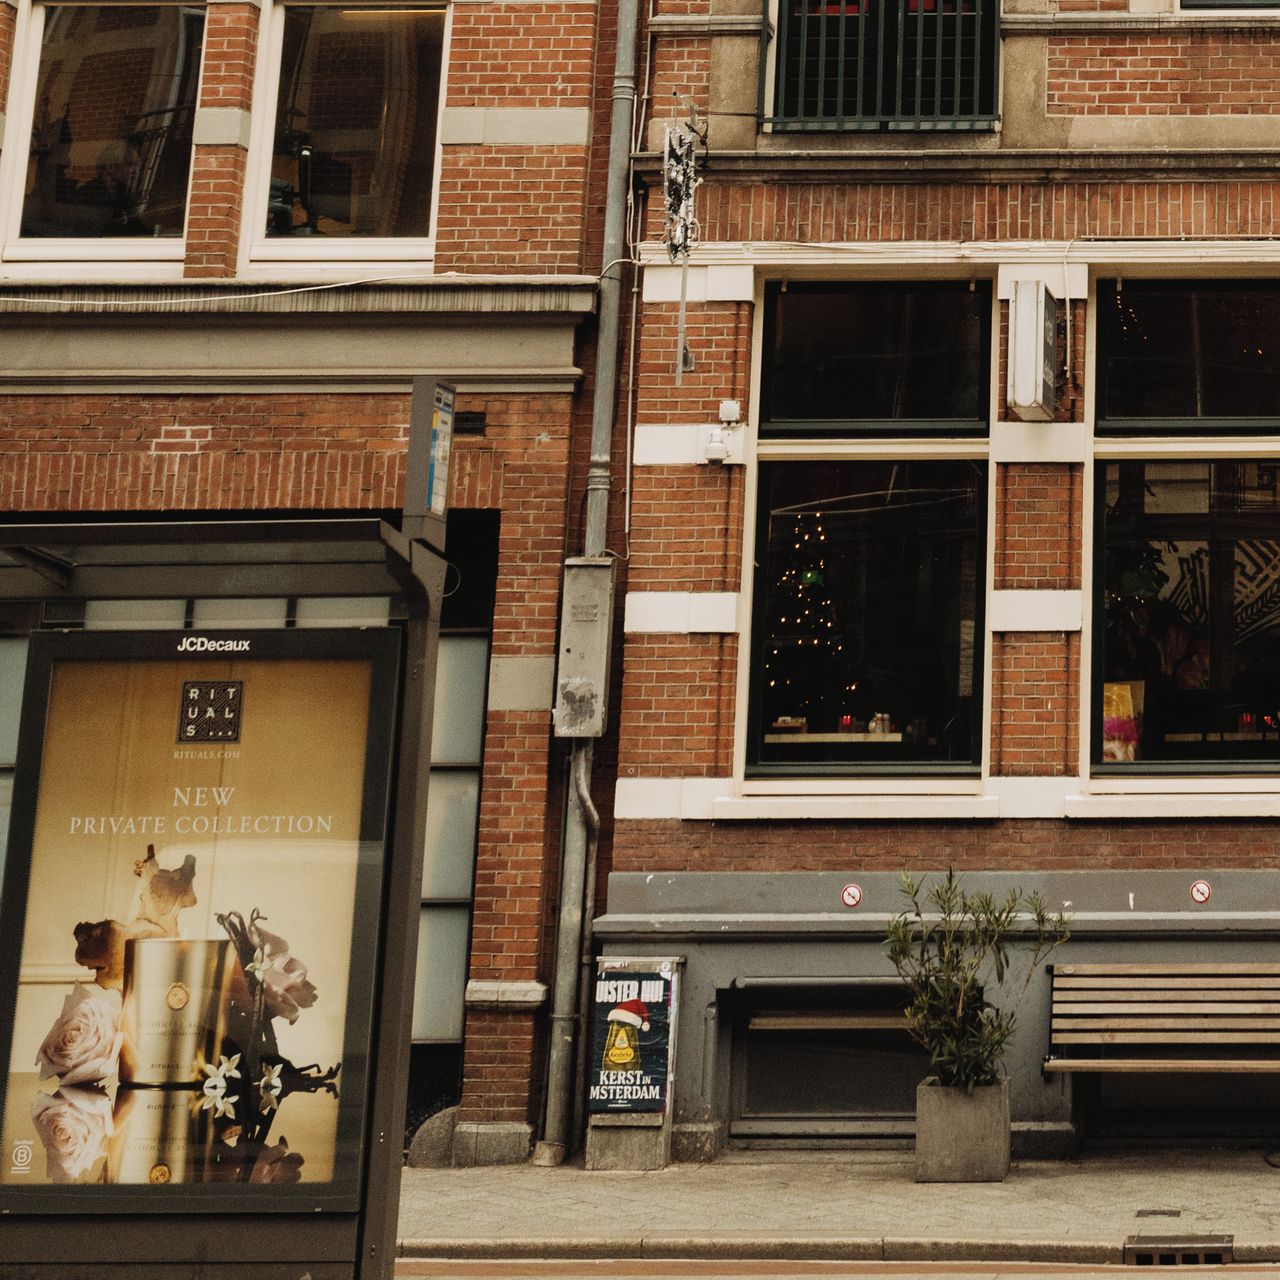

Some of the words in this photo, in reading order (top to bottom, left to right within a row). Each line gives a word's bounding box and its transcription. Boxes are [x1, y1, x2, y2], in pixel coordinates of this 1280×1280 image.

[177, 637, 251, 652] JCDecaux
[173, 750, 241, 760] RITUALS.COM
[172, 786, 237, 808] NEW
[69, 815, 167, 835] PRIVATE
[175, 814, 334, 835] COLLECTION
[600, 1070, 643, 1084] KERST
[590, 1086, 660, 1099] MSTERDAM
